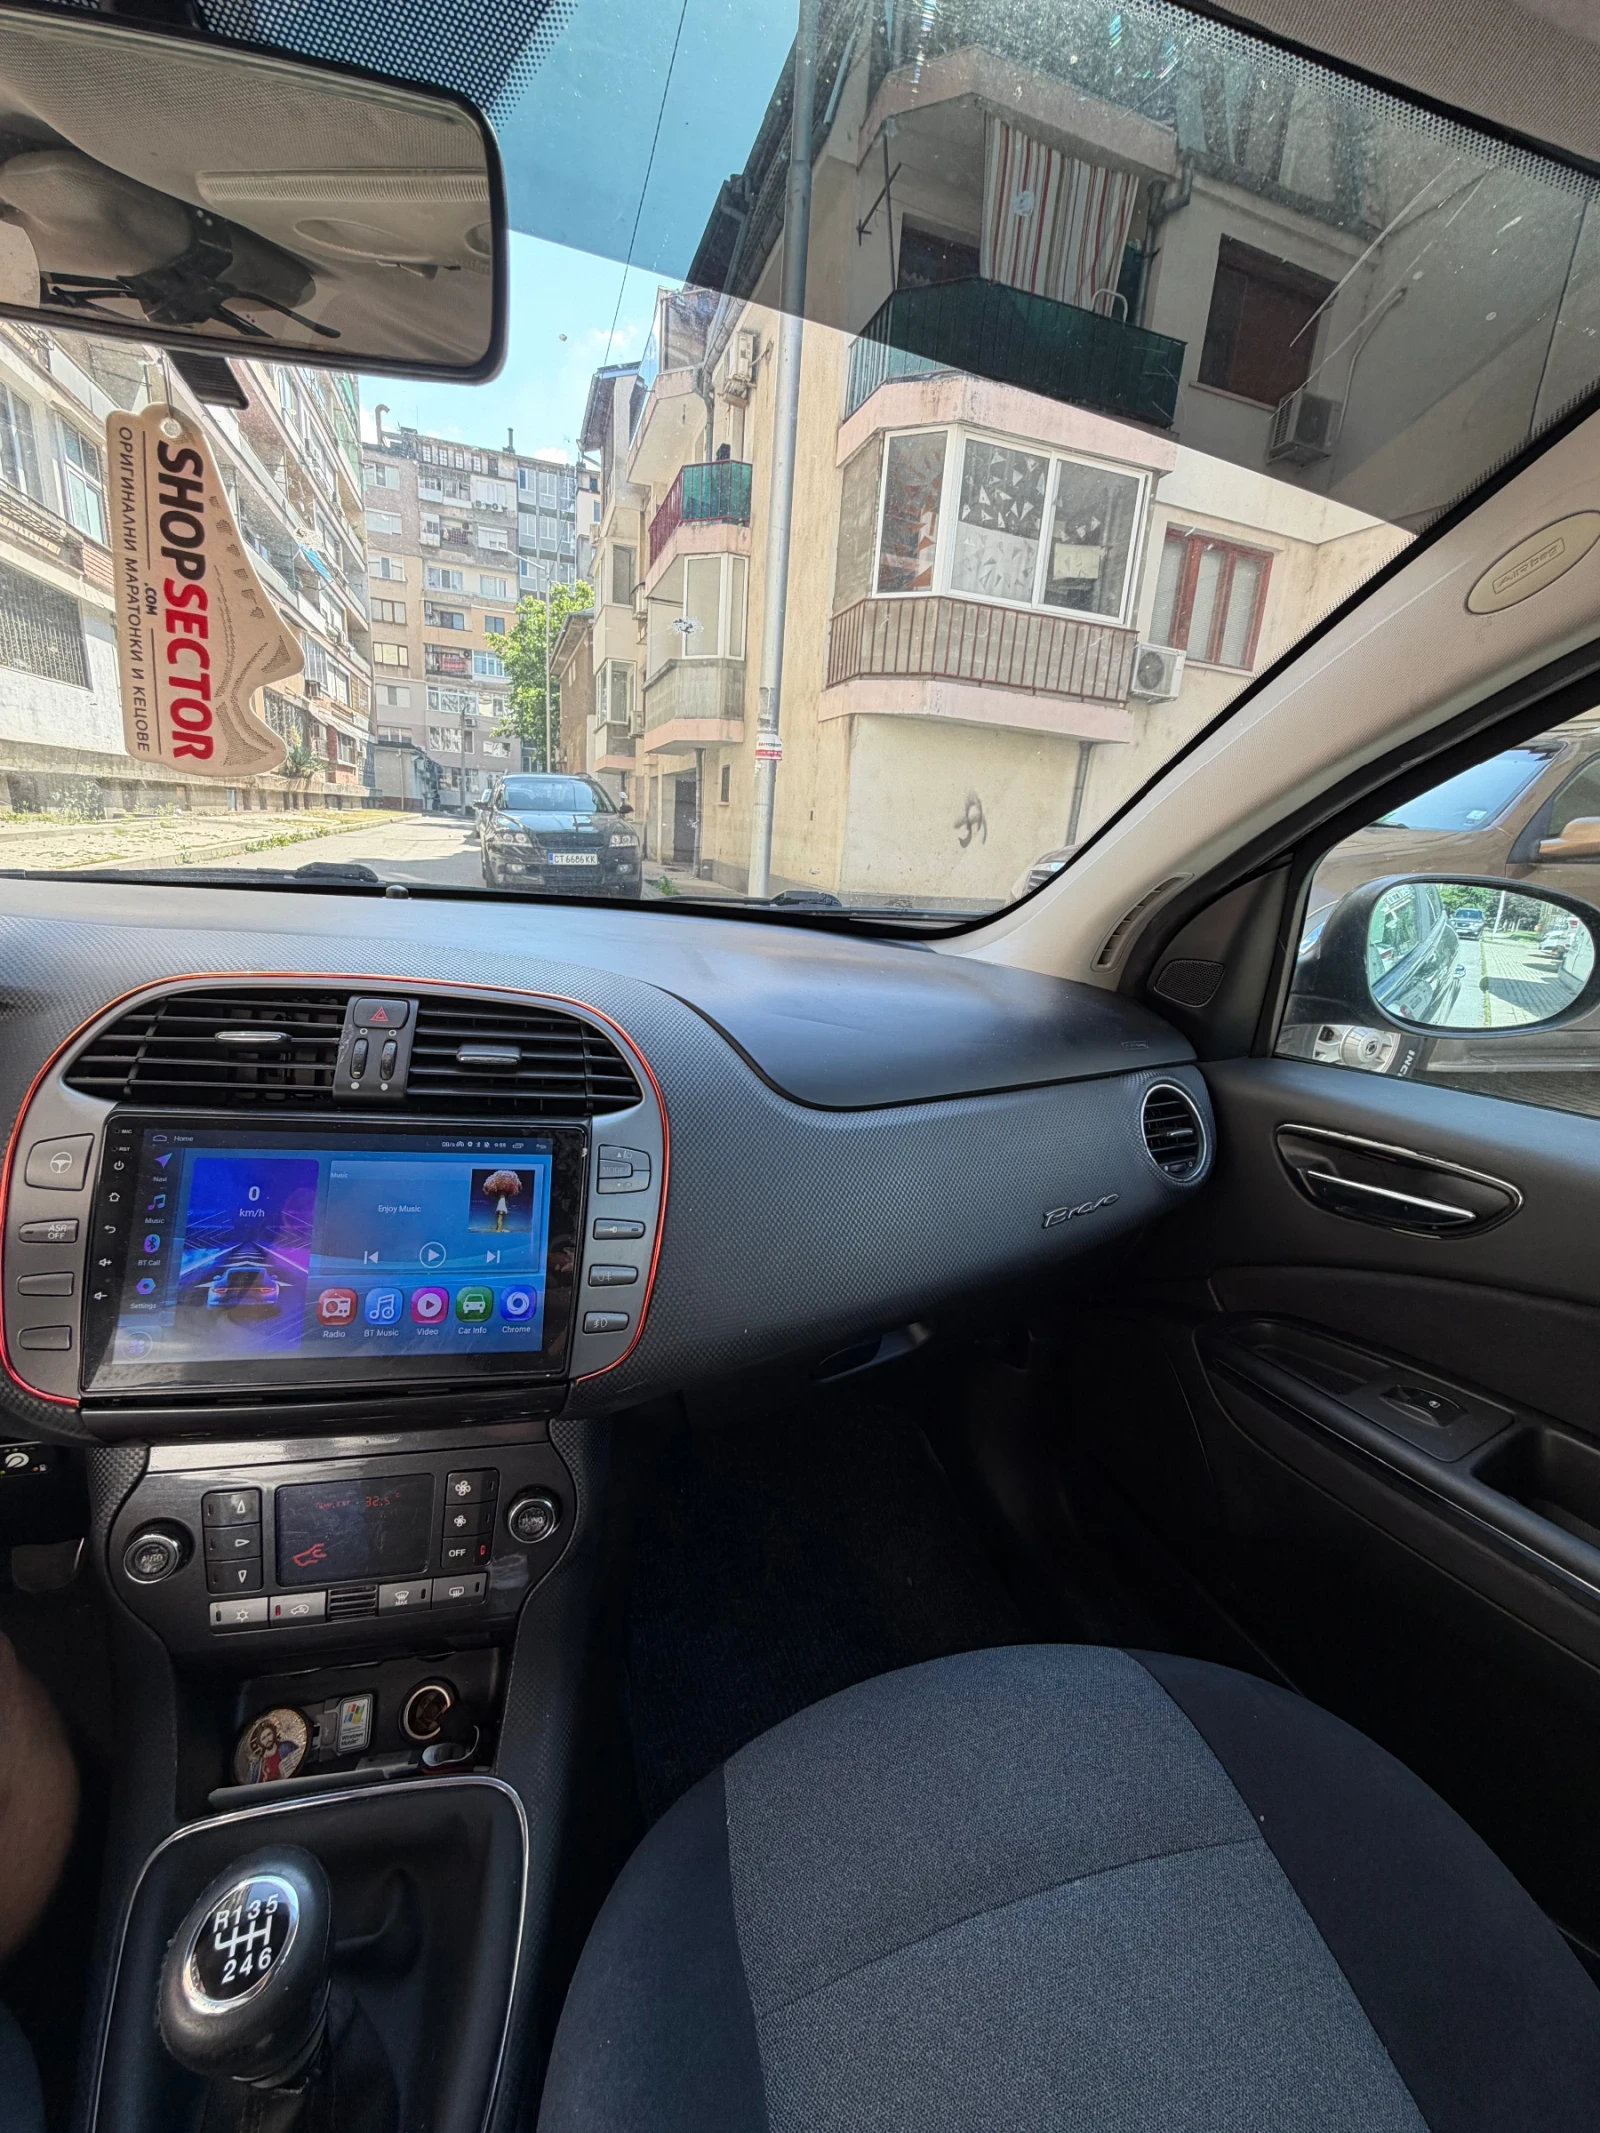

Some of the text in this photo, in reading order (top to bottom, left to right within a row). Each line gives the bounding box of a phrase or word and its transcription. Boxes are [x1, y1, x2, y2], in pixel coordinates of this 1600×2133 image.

[118, 426, 151, 753] ОРИГИНАЛНИ МАРАТОНКИ И КЕЦОВЕ
[143, 581, 158, 616] .COM
[156, 439, 215, 761] SHOPSECTOR
[248, 1185, 261, 1201] 0
[239, 1208, 266, 1218] km/h
[377, 1205, 422, 1214] Enjoy Music
[47, 1224, 68, 1232] ASR
[47, 1232, 66, 1240] OFF
[322, 1329, 347, 1339] Radio
[363, 1328, 400, 1338] BT Music
[416, 1327, 439, 1336] Video
[457, 1325, 488, 1335] Car Info
[501, 1325, 532, 1334] Chrome
[448, 1548, 467, 1557] OFF
[220, 1946, 272, 1985] 2 4 6
